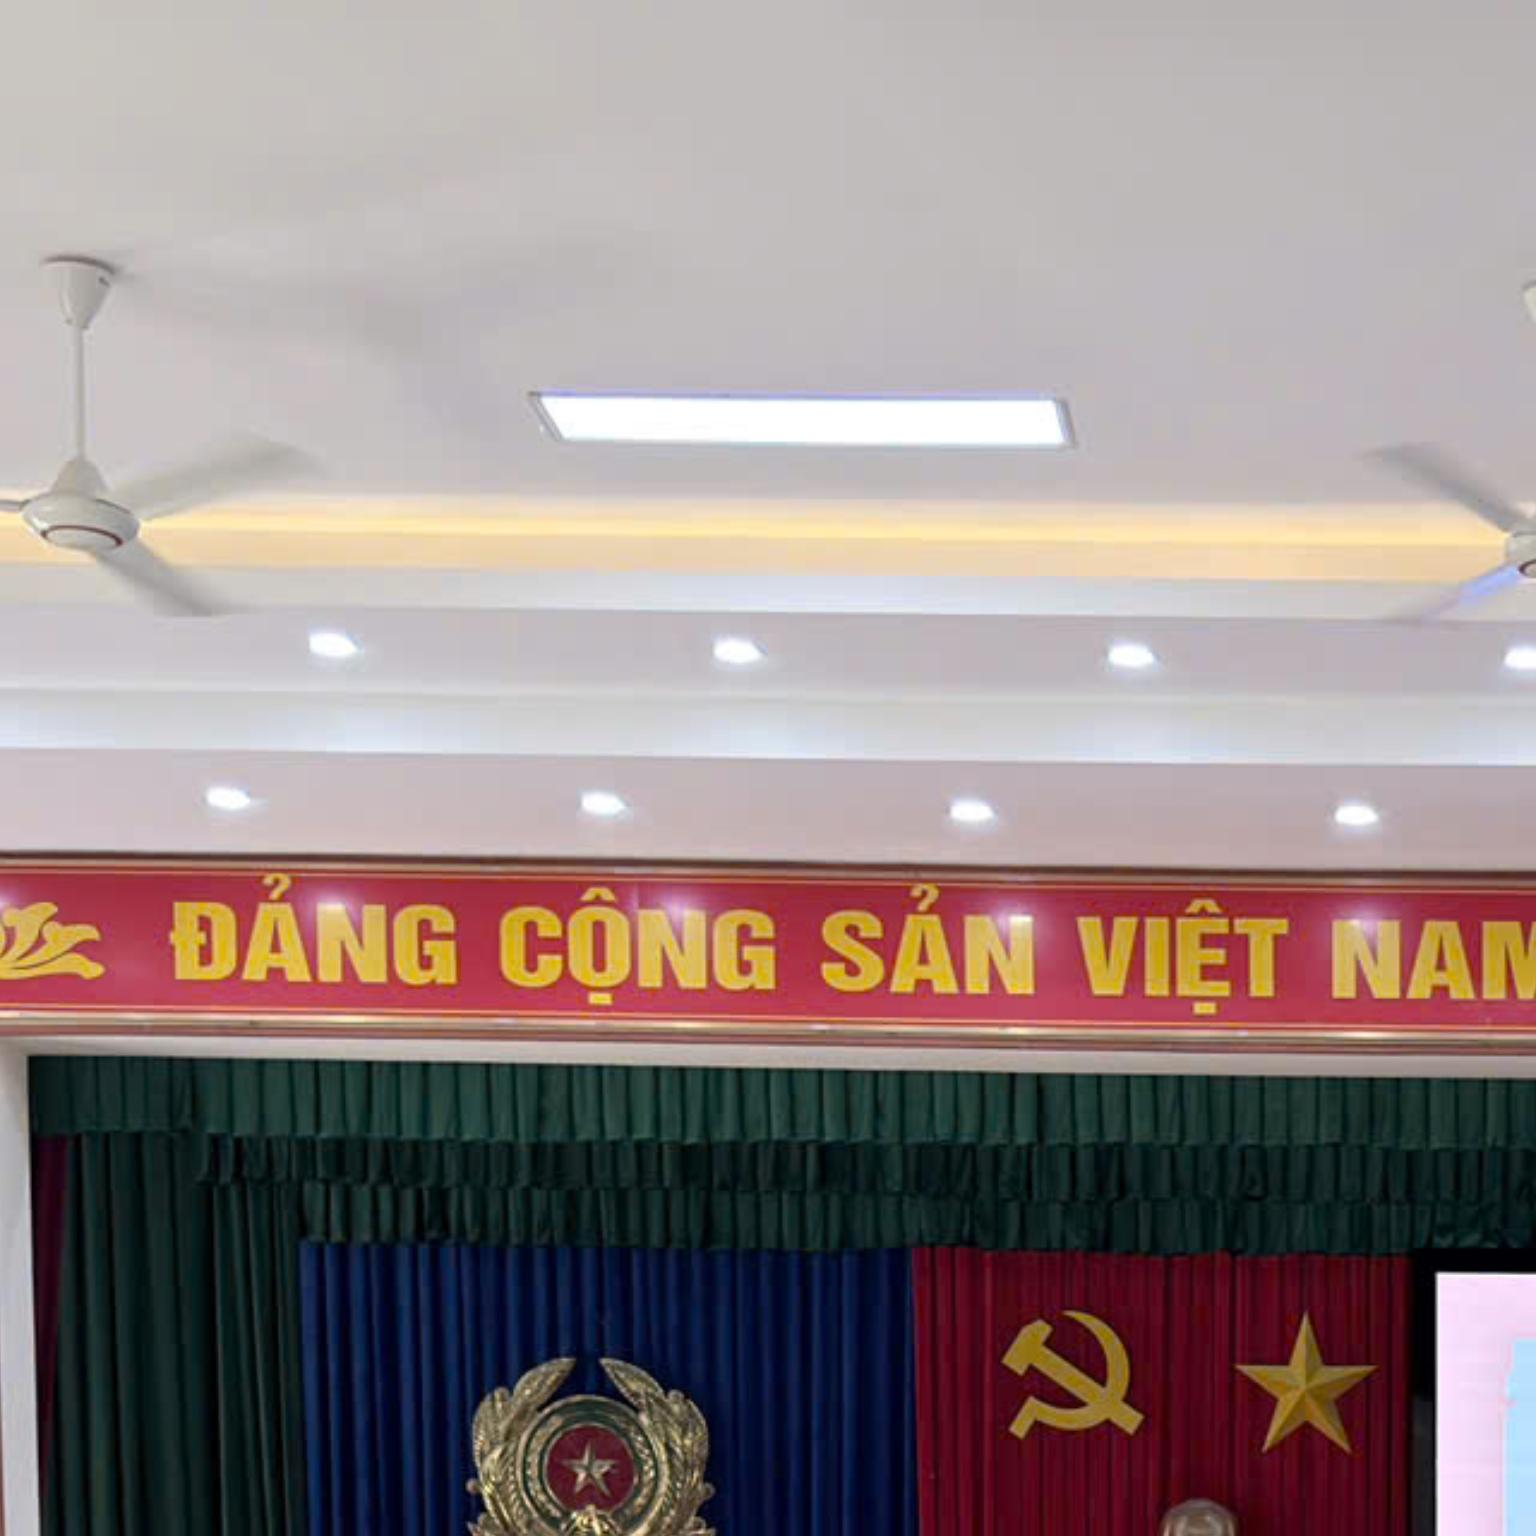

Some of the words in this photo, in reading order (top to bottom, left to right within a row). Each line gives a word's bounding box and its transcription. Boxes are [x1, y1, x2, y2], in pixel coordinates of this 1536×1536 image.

[169, 876, 458, 986] ĐẢNG
[500, 884, 776, 1006] CỘNG
[822, 880, 1036, 997] SẢN
[1079, 898, 1290, 1014] VIỆT
